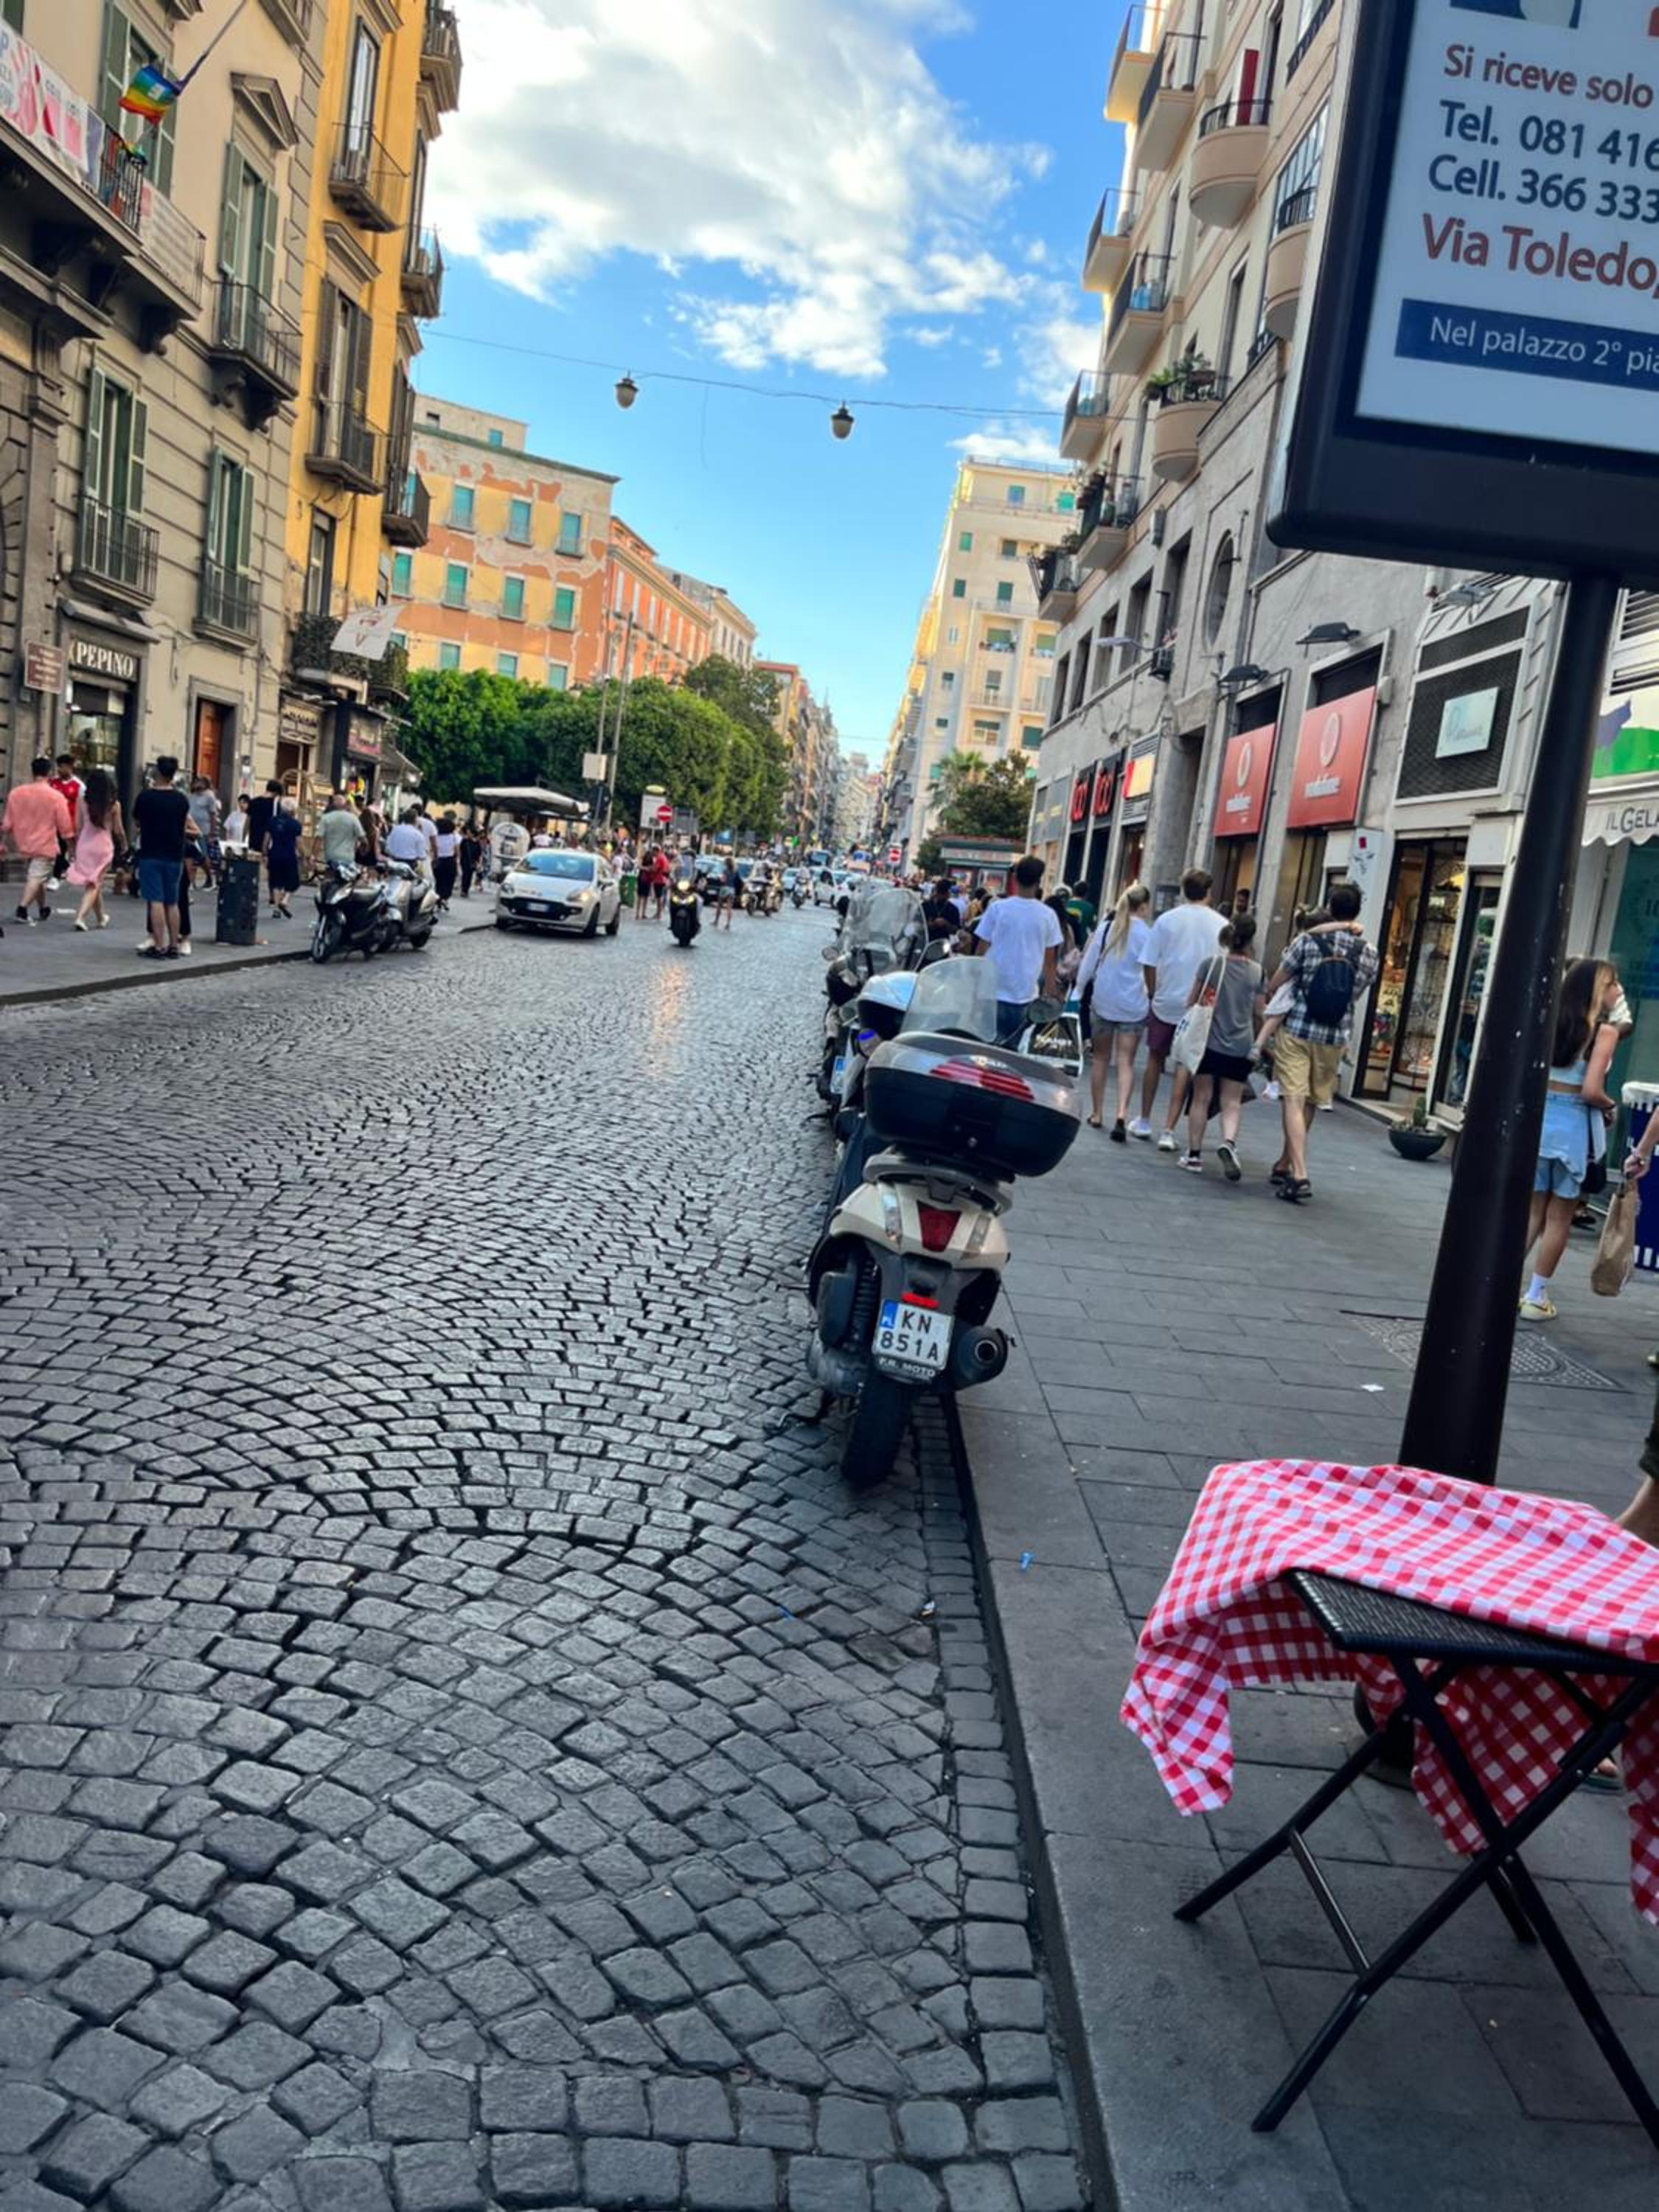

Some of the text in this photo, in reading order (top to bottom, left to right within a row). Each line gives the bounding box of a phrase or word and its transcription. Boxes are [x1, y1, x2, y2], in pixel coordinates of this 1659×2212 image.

[1444, 44, 1654, 108] Si riceve solo
[1439, 99, 1499, 146] Tel.
[1519, 115, 1585, 159] 081
[1428, 153, 1659, 225] Cell. 366 333
[1422, 212, 1489, 267] Via
[1430, 316, 1476, 348] Nel
[1481, 327, 1586, 363] palazzo
[75, 641, 134, 679] PEPINO
[880, 1330, 939, 1362] 851A
[901, 1310, 933, 1335] KN
